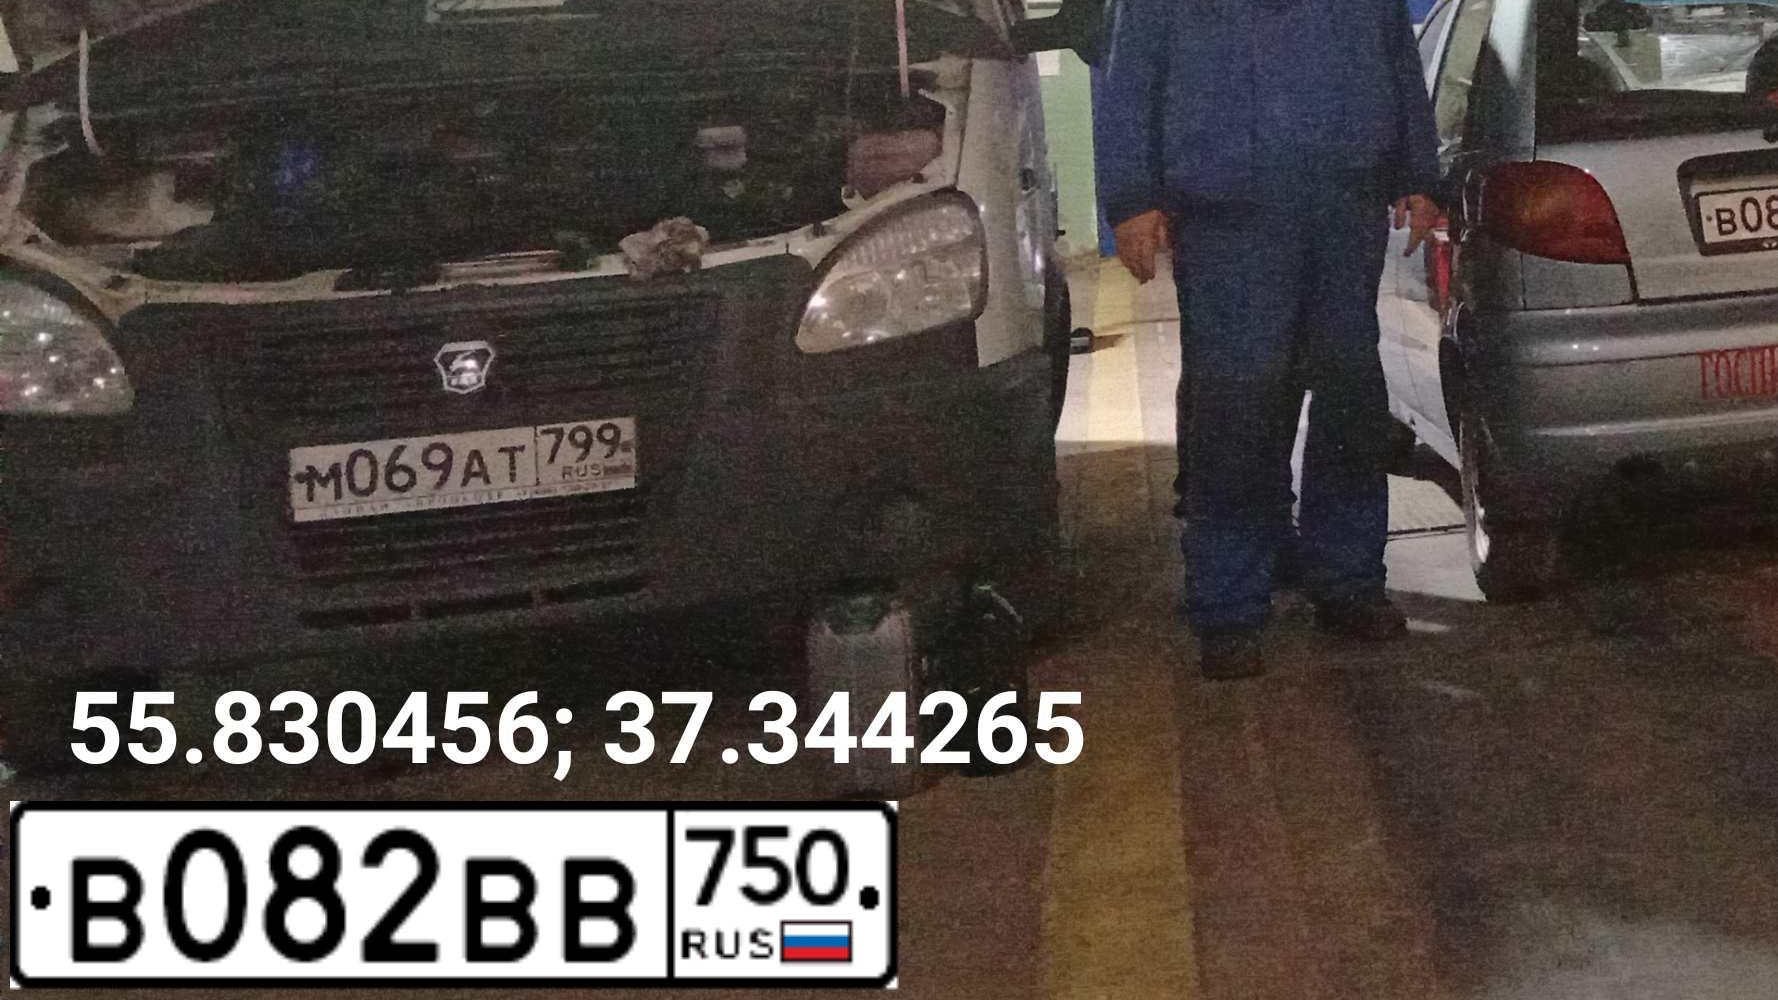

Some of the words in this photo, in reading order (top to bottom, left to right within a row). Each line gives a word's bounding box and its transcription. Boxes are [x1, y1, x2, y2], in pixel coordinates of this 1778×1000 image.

[306, 442, 525, 502] М069АТ
[541, 422, 621, 464] 799
[562, 462, 601, 480] RUS
